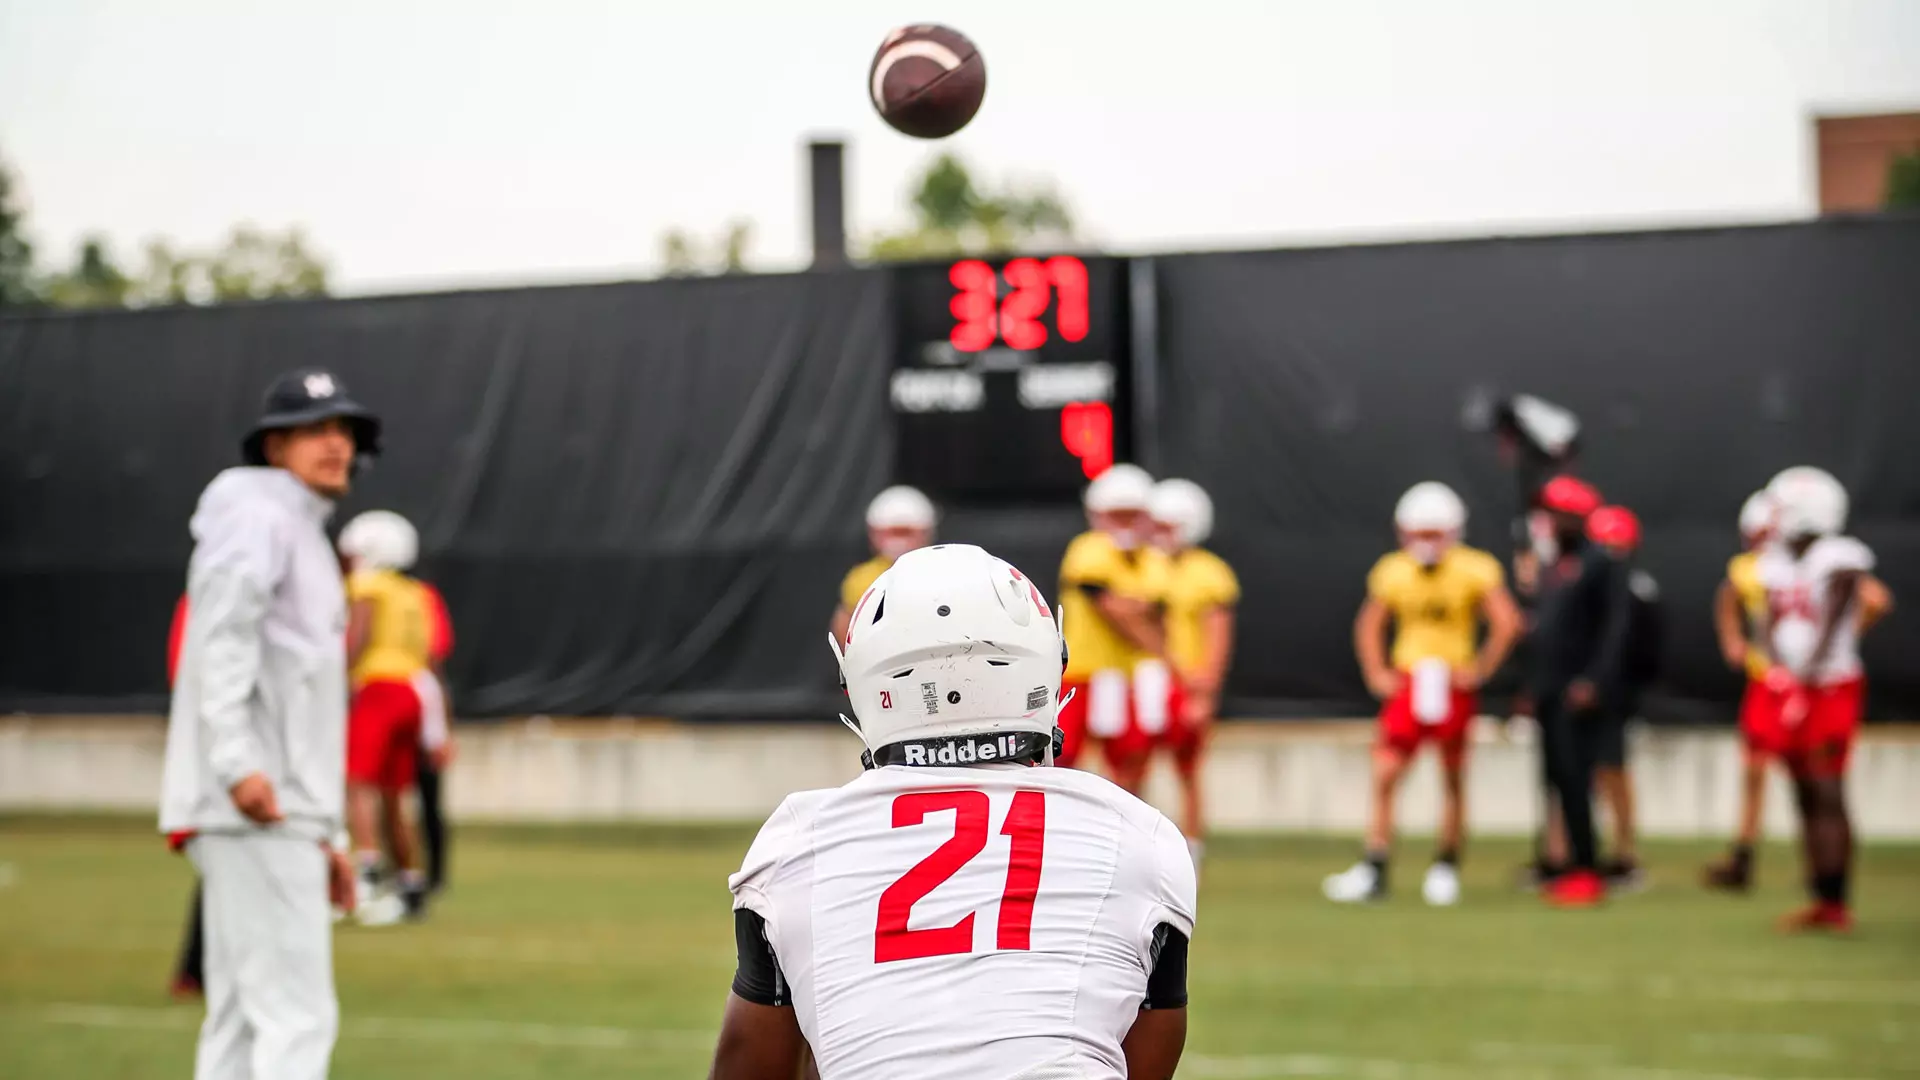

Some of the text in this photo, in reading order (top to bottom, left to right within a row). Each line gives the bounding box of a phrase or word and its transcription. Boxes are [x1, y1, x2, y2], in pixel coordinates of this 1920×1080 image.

[879, 690, 893, 709] 21
[904, 735, 1017, 766] Riddell
[874, 789, 1046, 964] 21
